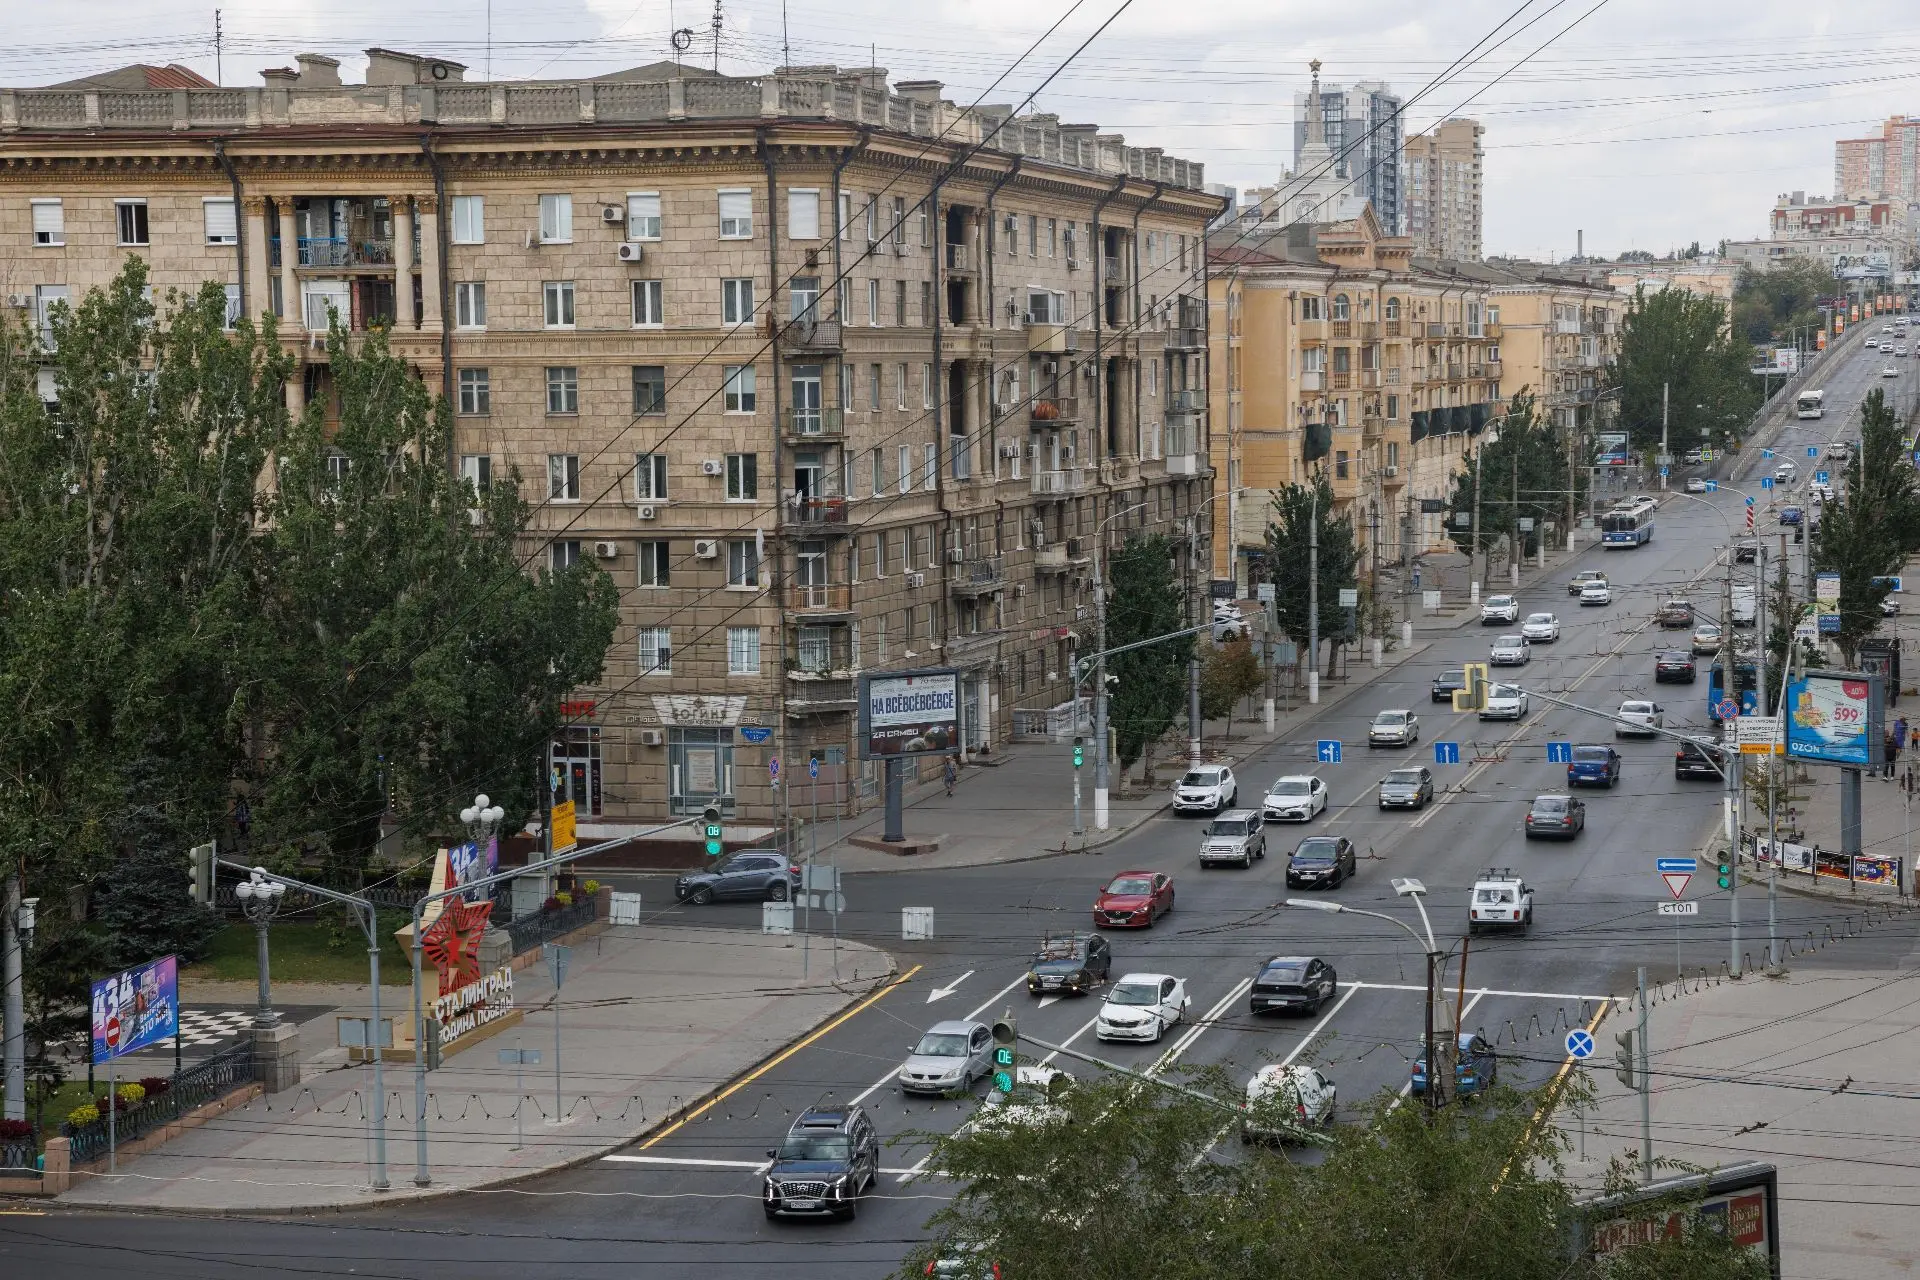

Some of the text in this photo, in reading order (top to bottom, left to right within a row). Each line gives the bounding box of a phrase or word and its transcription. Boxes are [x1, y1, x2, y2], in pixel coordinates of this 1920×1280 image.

[872, 690, 954, 714] НА ВСЁВСЁВСЁВСЁ
[672, 708, 728, 720] БОГИНЯ
[1791, 742, 1820, 753] OZON
[1663, 903, 1692, 913] СТОП
[435, 966, 513, 1022] СТАЛИНГРАД
[477, 993, 514, 1026] ПОБЕДЫ
